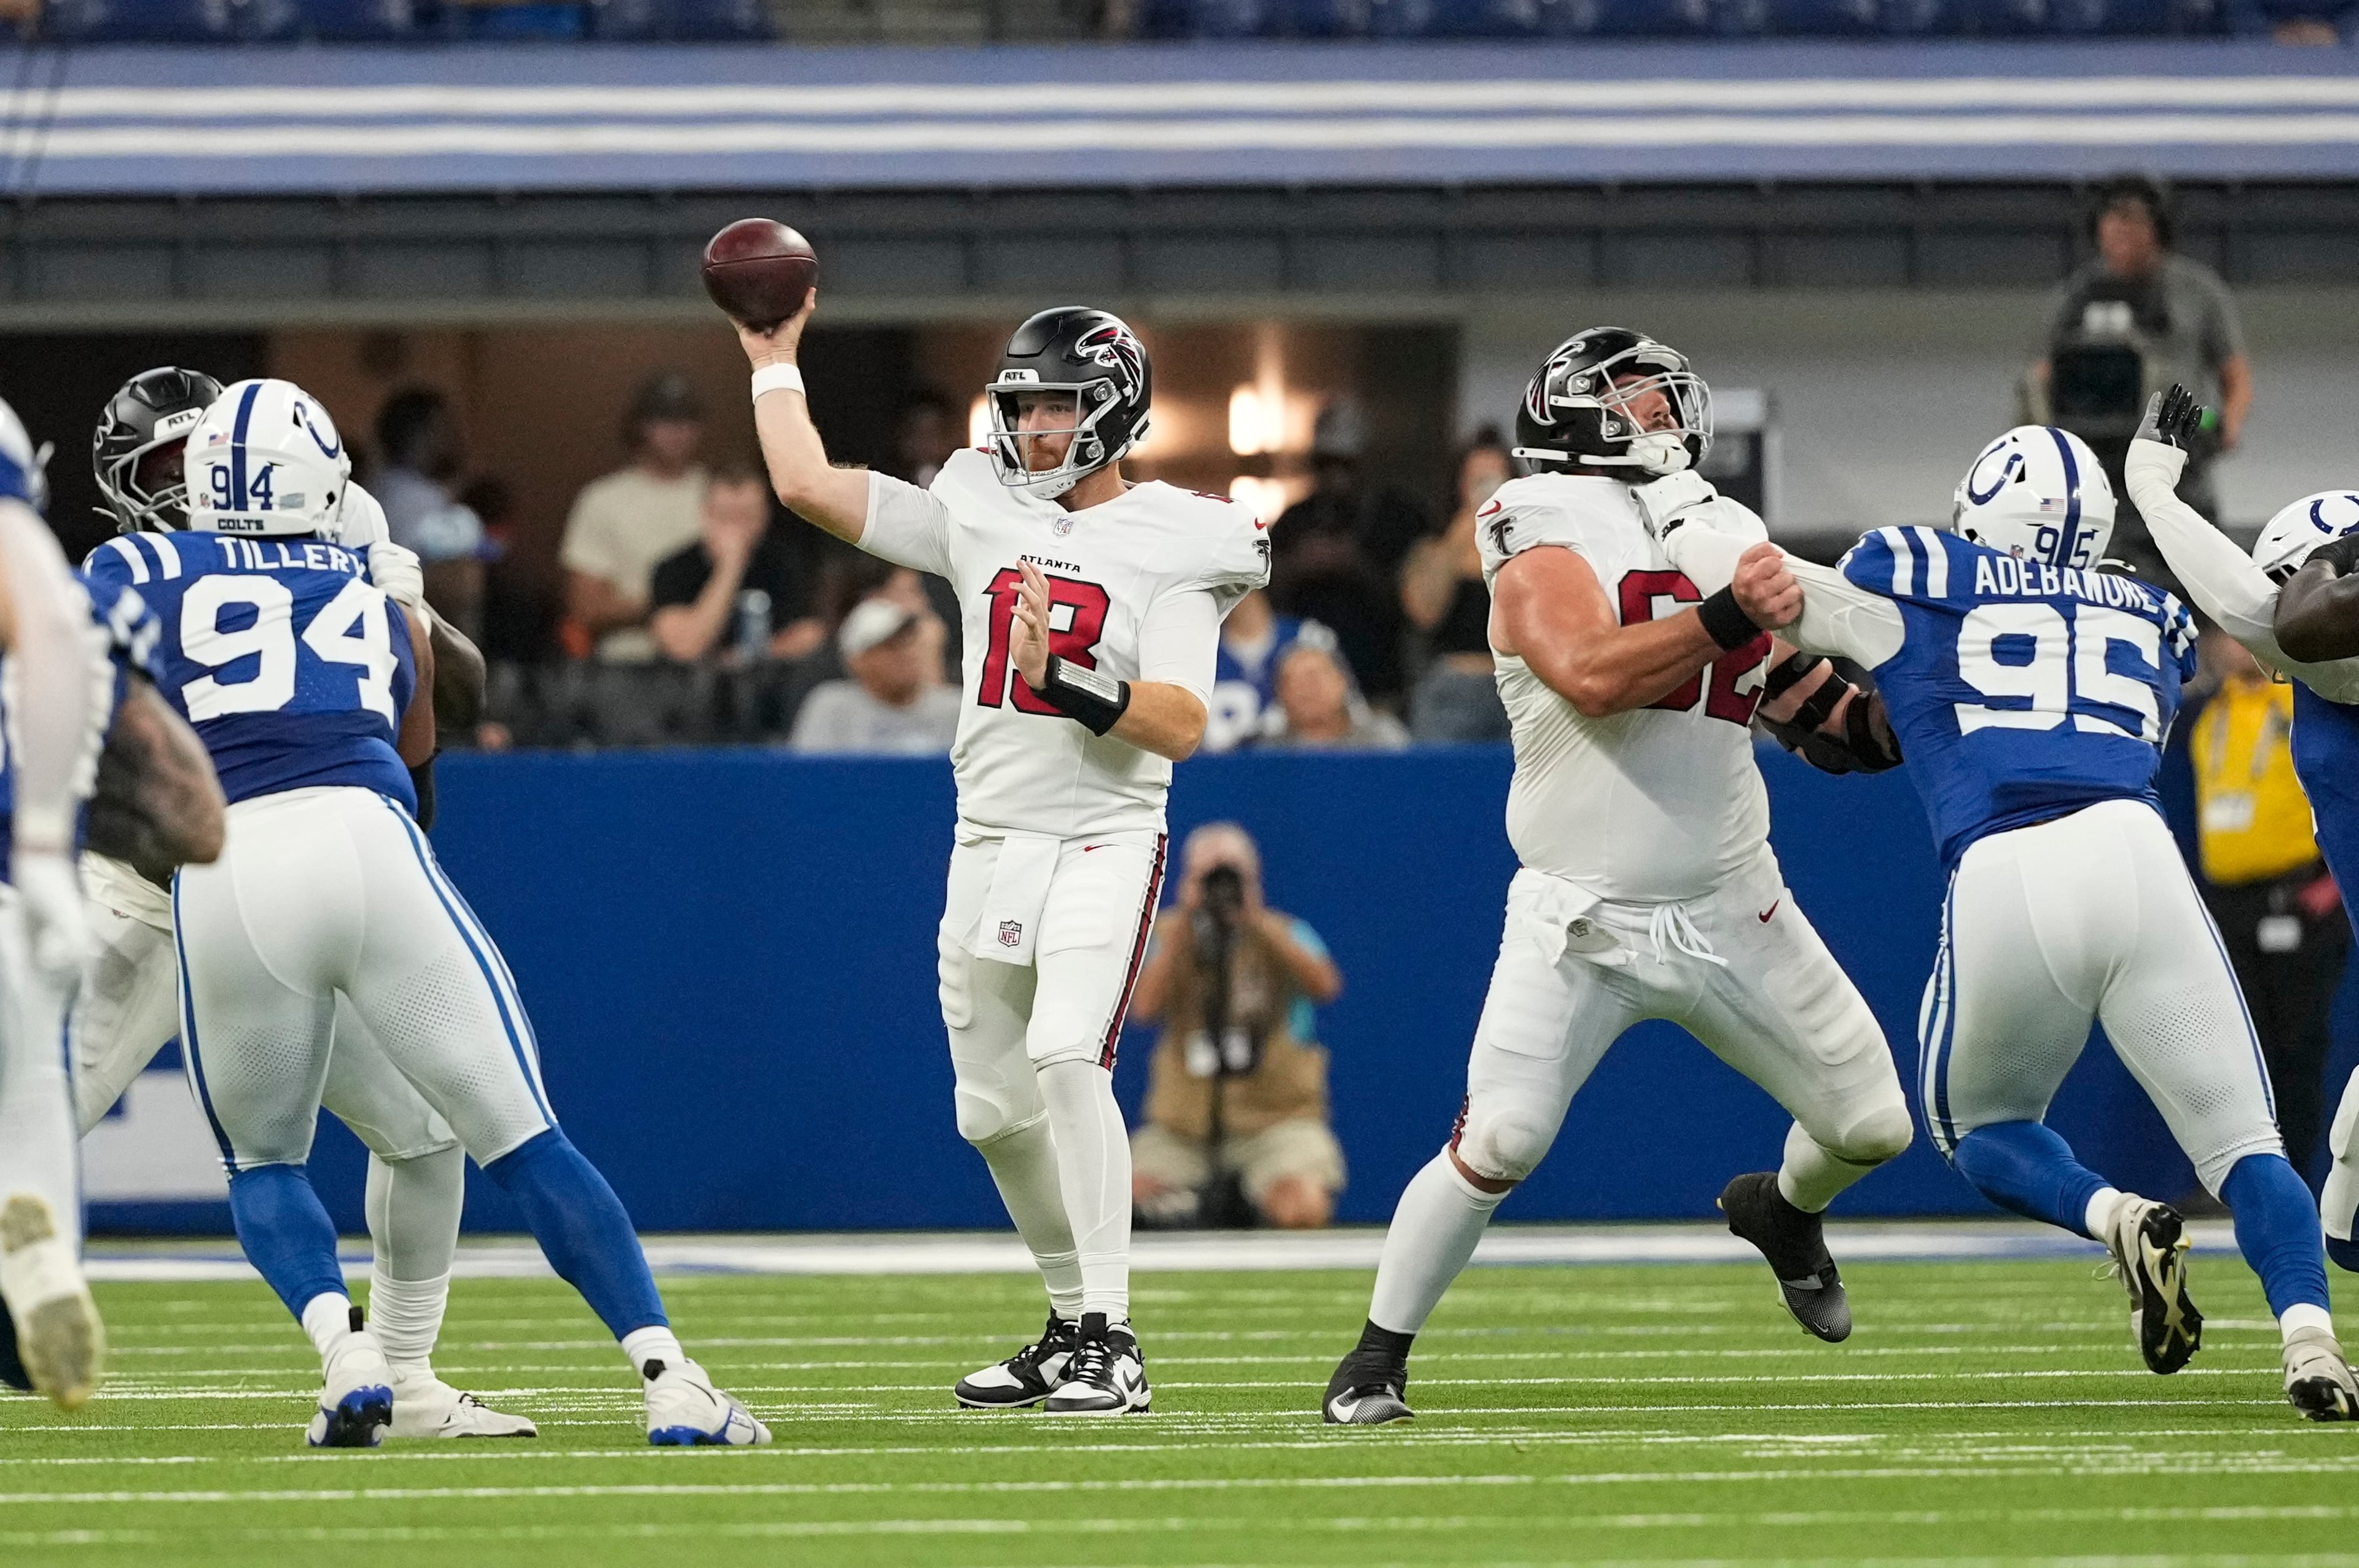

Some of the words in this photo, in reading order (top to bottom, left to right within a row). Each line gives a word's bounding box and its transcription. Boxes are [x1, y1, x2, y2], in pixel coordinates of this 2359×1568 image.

[1004, 372, 1027, 383] ATL
[168, 413, 195, 428] ATL
[212, 465, 273, 510] 94
[218, 518, 264, 530] COLTS
[215, 536, 367, 577] TILLERY
[1020, 555, 1081, 572] ATLANTA
[180, 574, 399, 730] 94
[1954, 603, 2162, 745] 95
[1001, 930, 1017, 943] NFL
